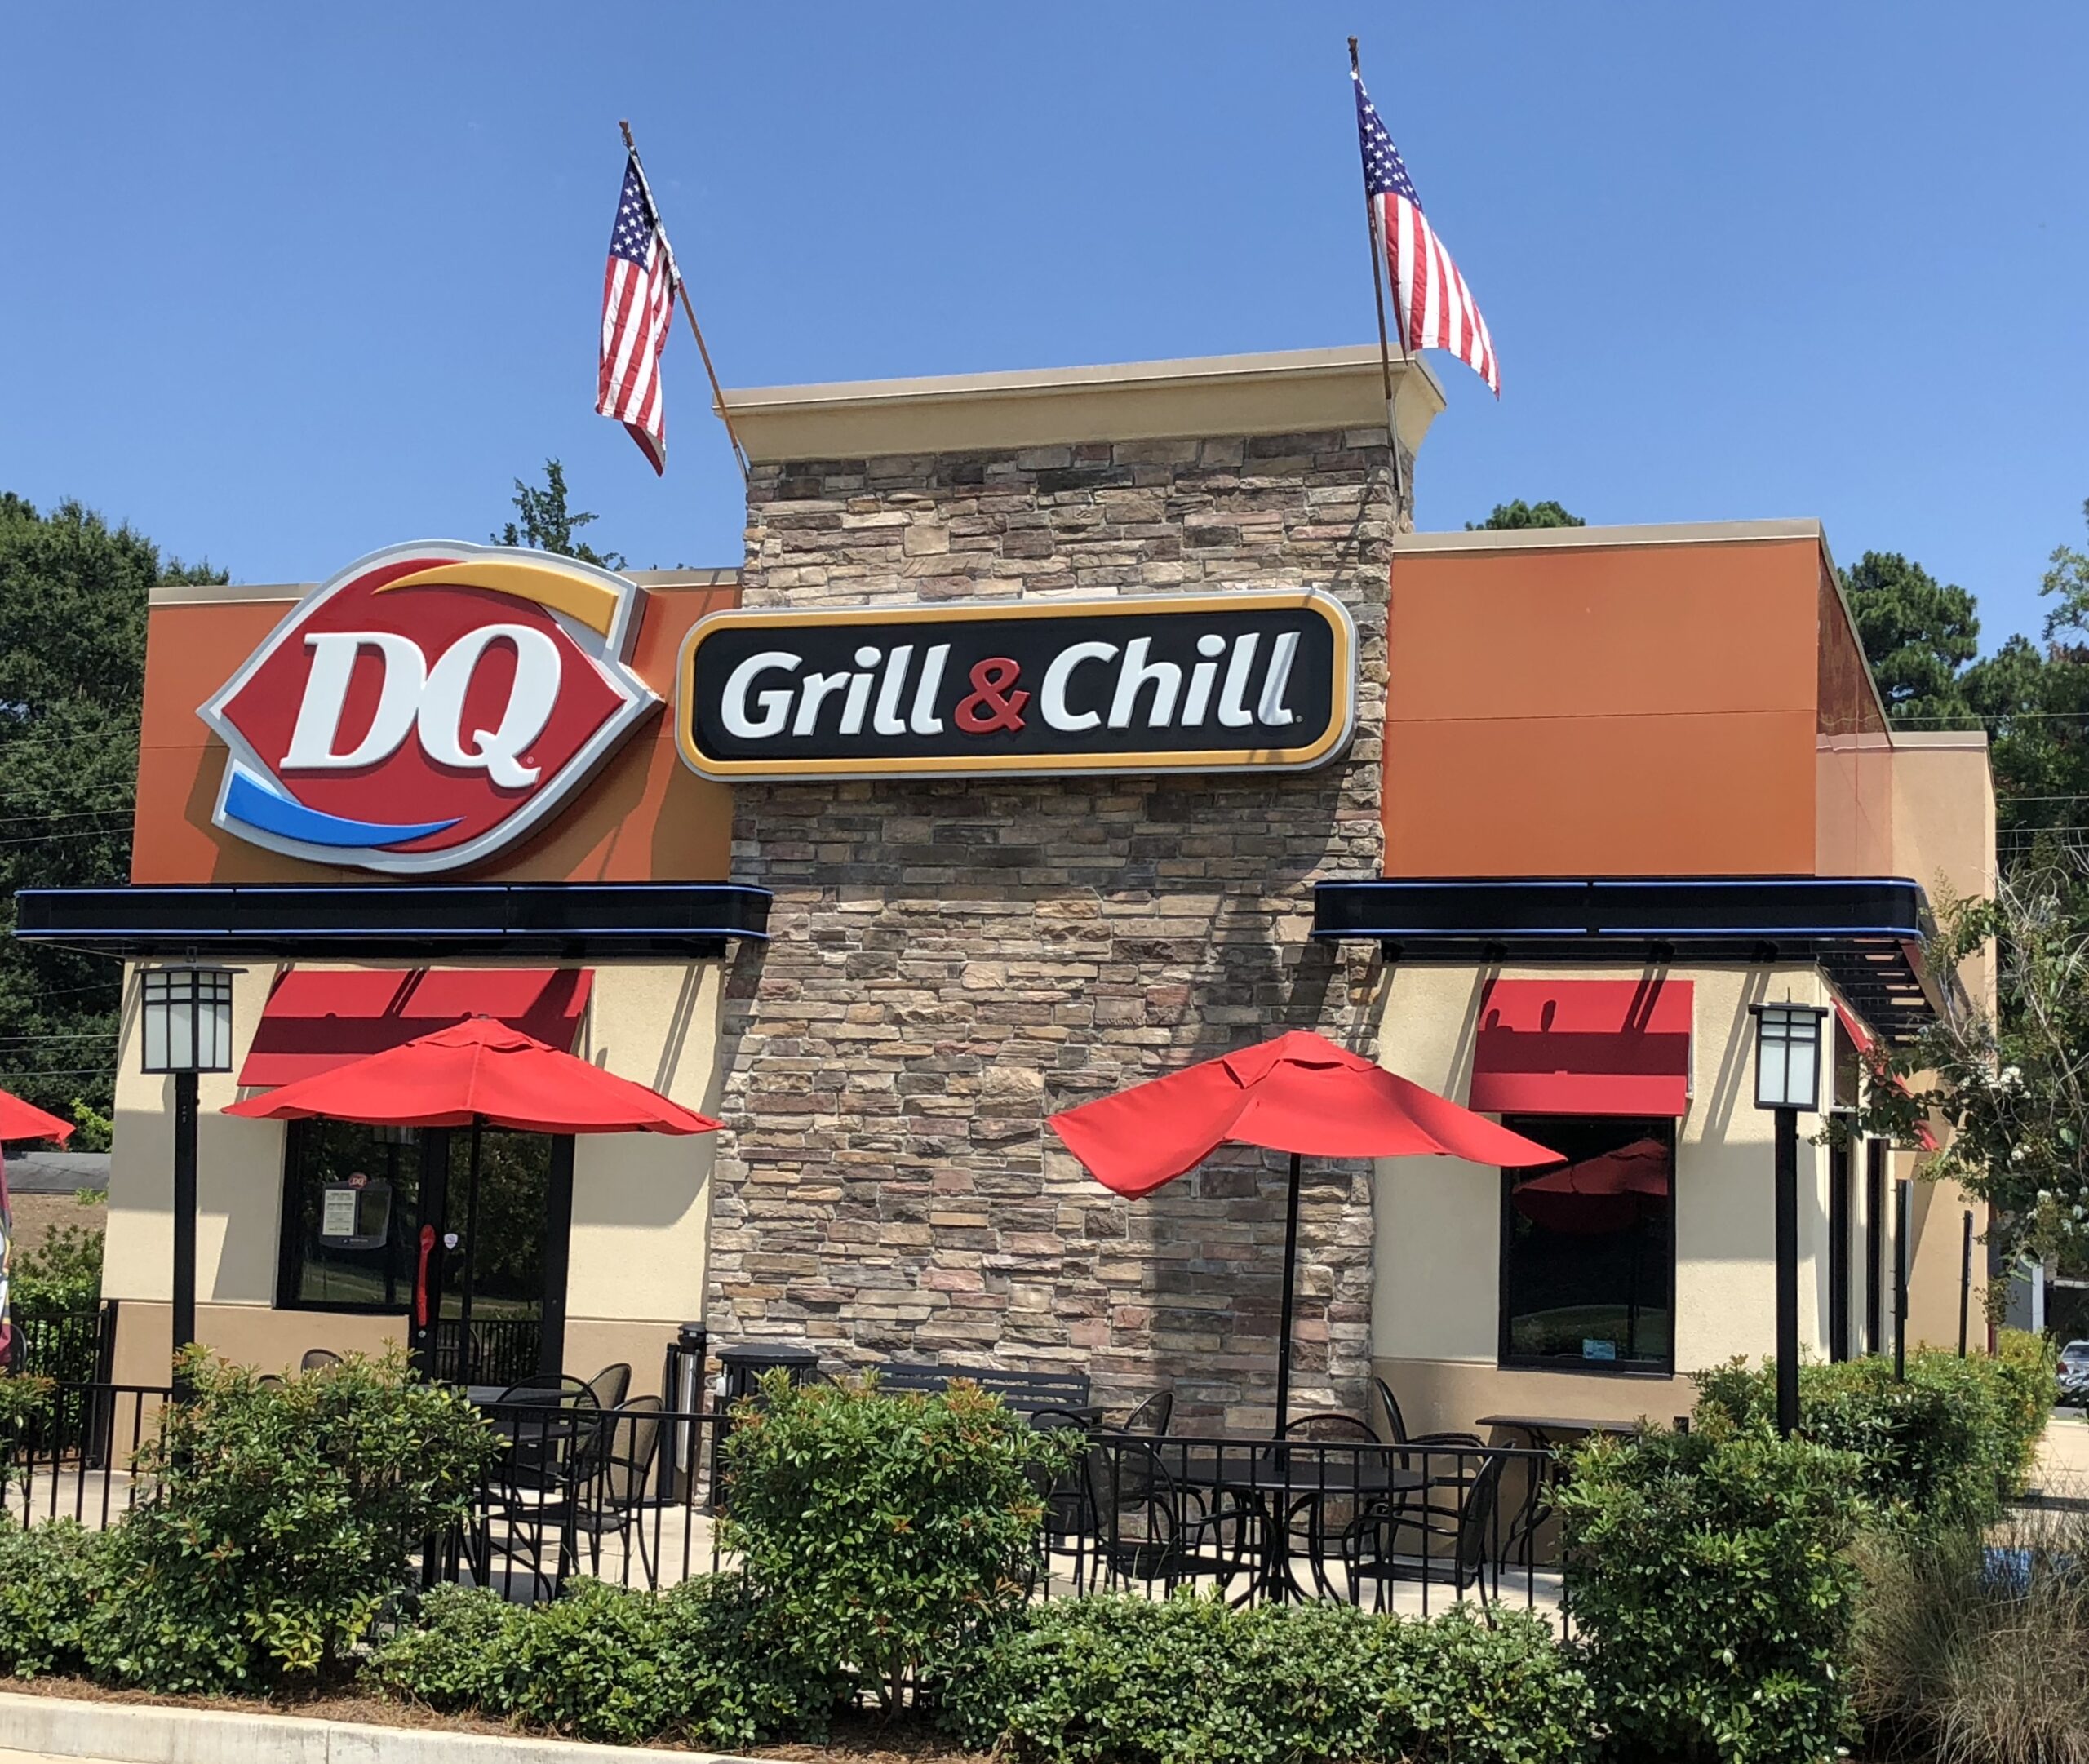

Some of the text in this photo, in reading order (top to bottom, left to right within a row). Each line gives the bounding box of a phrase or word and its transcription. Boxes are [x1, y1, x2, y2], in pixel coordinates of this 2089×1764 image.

[279, 623, 562, 788] DQ
[721, 632, 1300, 738] Grill & Chill
